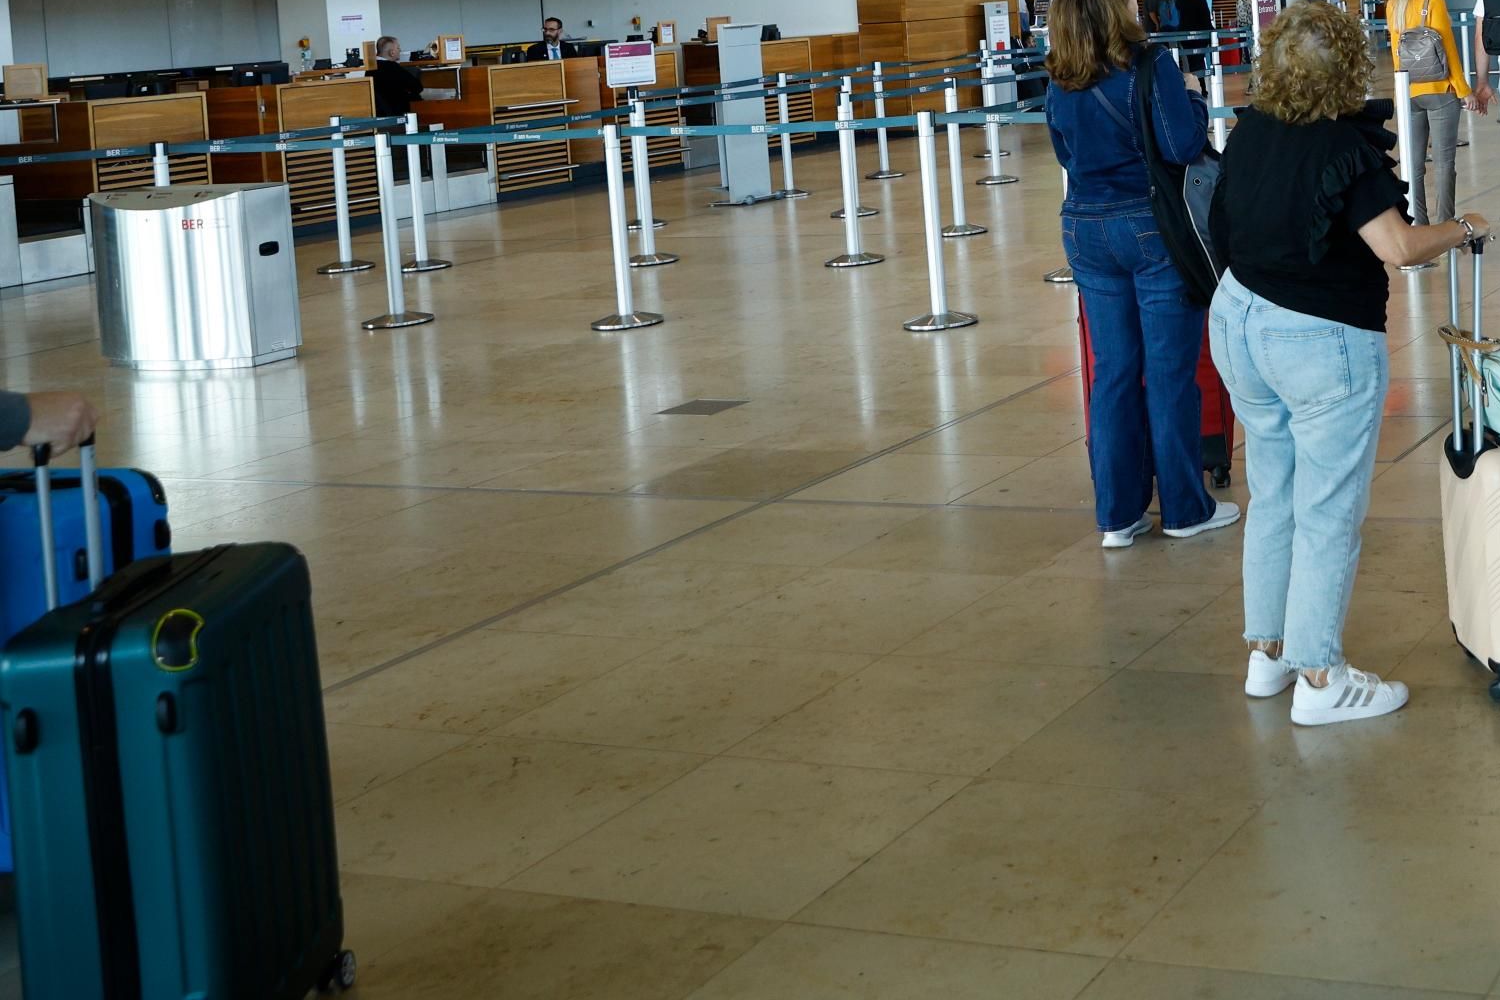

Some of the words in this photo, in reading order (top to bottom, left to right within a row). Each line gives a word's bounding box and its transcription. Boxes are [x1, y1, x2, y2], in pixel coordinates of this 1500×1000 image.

[986, 114, 1000, 122] BER
[752, 125, 765, 133] BER
[835, 122, 849, 130] BER
[670, 127, 684, 135] BER
[106, 149, 121, 157] BER
[18, 156, 33, 164] BER
[181, 219, 204, 230] BER
